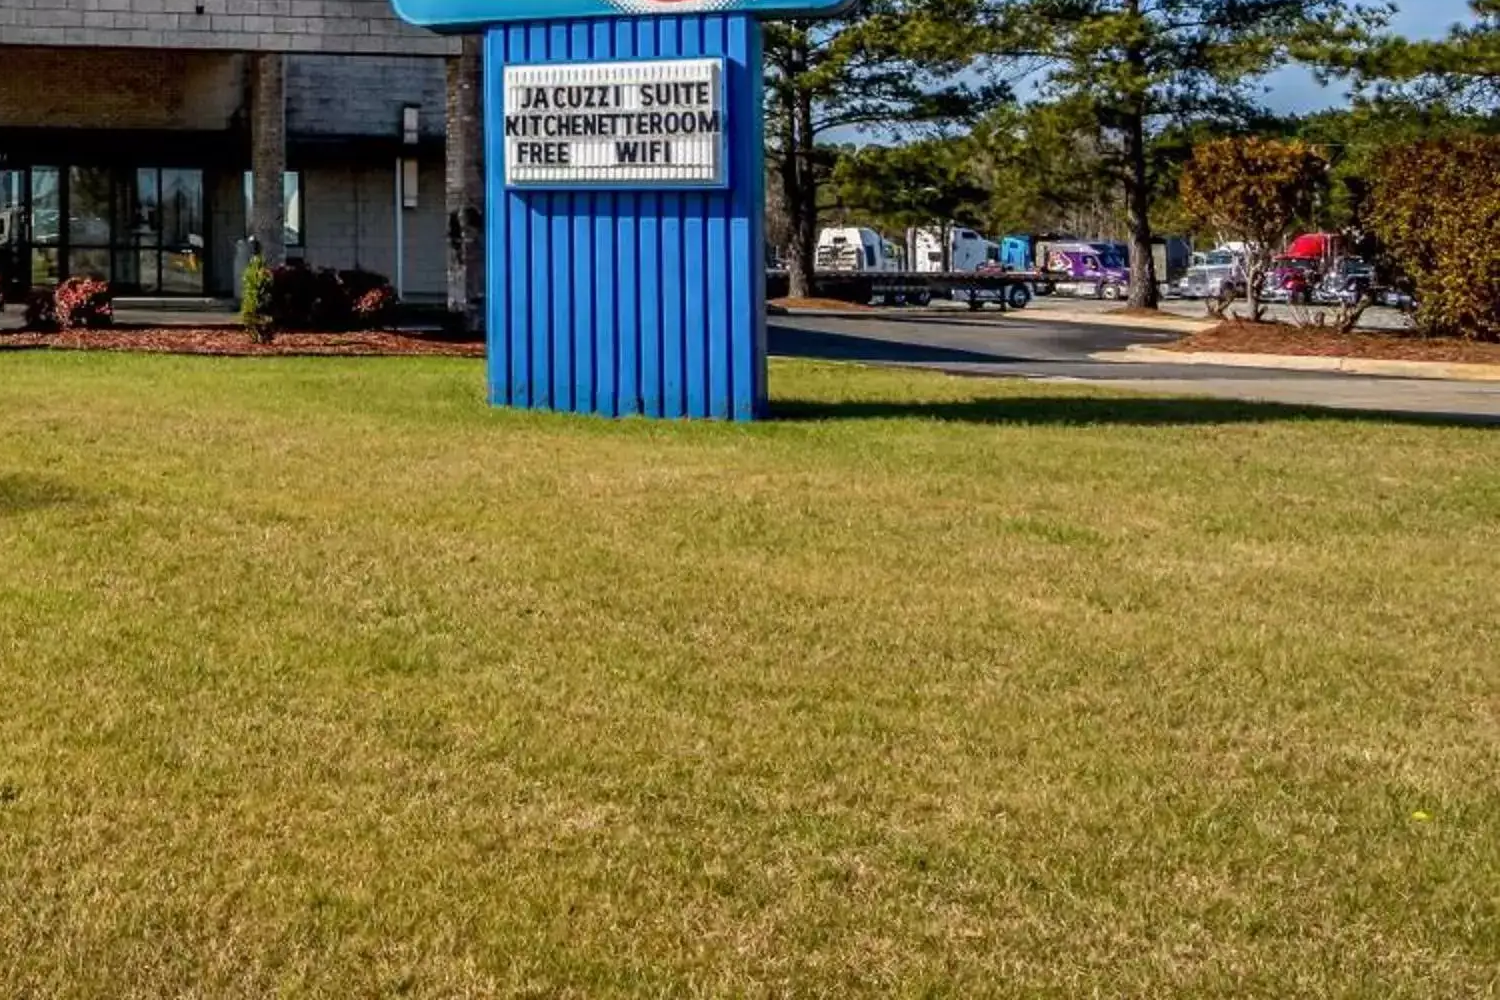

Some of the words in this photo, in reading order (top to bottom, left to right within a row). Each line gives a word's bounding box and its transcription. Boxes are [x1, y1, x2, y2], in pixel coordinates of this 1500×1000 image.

[521, 86, 621, 109] JACUZZI
[641, 81, 709, 106] SUITE
[517, 142, 571, 163] FREE
[616, 140, 671, 163] WIFI
